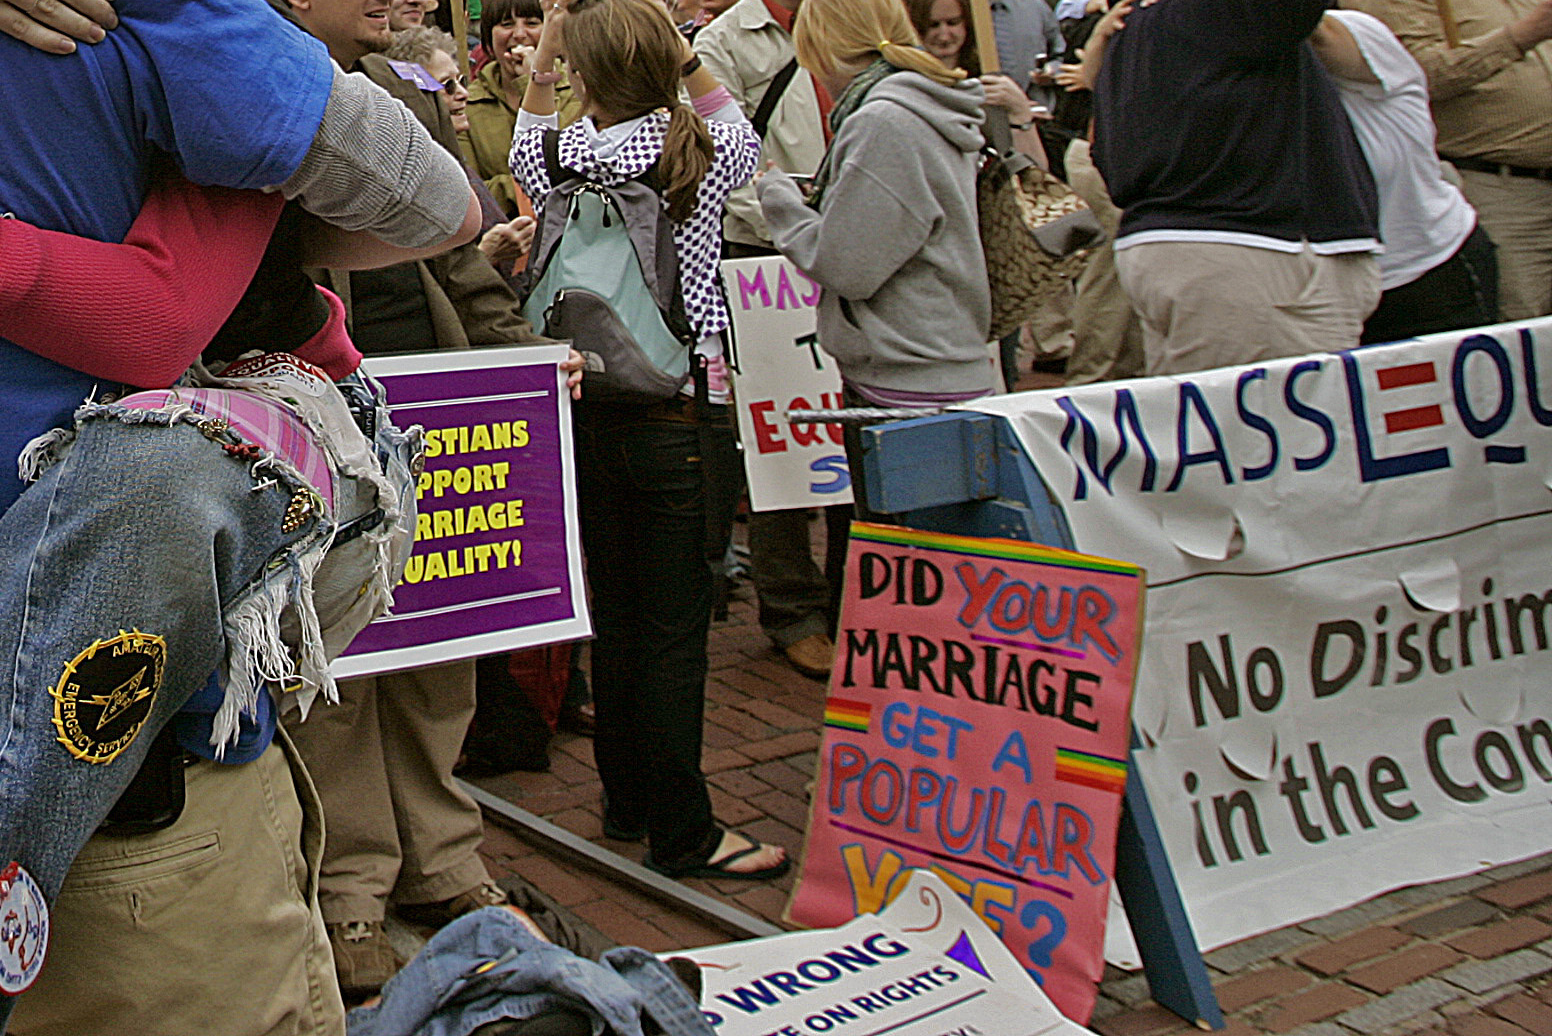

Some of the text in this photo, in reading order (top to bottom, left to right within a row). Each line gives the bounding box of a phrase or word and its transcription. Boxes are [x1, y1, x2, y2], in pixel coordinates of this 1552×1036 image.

[397, 539, 522, 585] UALITY!
[859, 552, 1123, 666] DID YOUR
[64, 682, 96, 747] EMERGENCY
[841, 629, 1103, 732] MARRIAGE
[1187, 633, 1284, 727] No
[882, 702, 1032, 784] GET A
[827, 742, 1107, 886] POPULAR
[1184, 770, 1270, 868] in
[1279, 742, 1422, 844] the
[715, 932, 911, 1015] WRONG
[805, 1004, 859, 1033] ON
[852, 965, 961, 1013] RIGHTS
